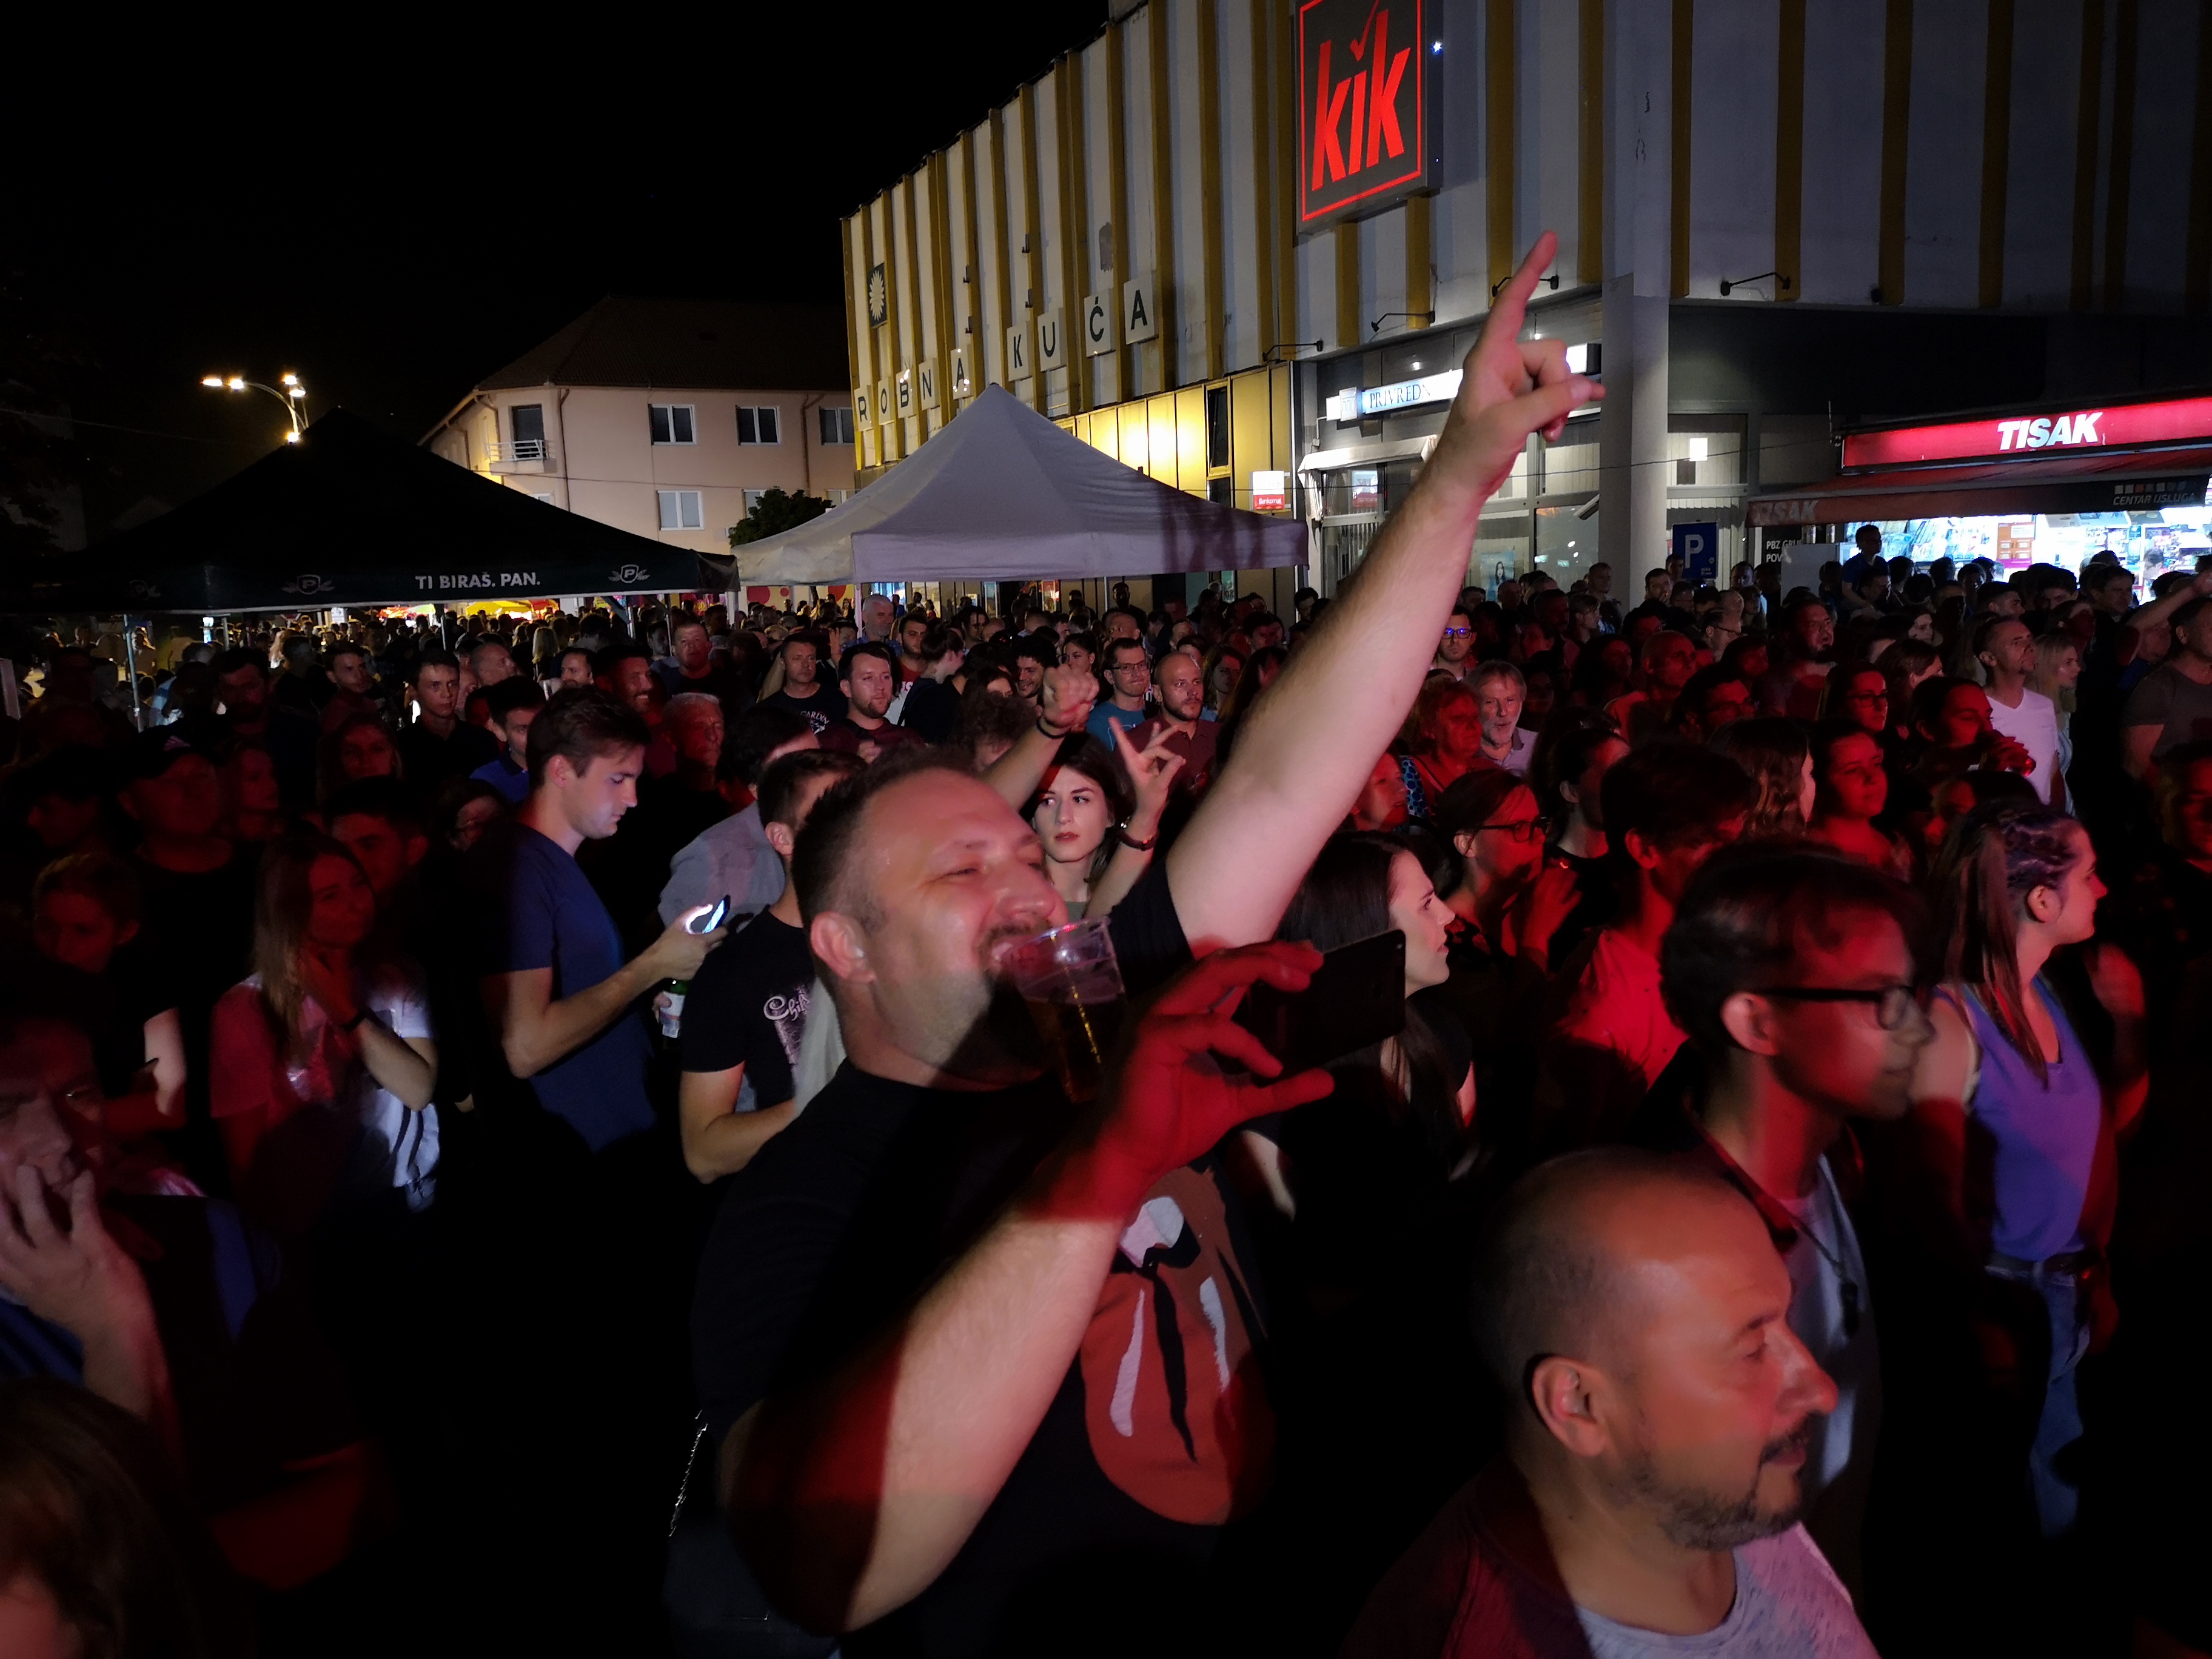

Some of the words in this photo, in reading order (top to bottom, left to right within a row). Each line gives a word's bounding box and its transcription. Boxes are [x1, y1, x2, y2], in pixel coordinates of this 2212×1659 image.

[858, 358, 968, 422] ROBNA
[1013, 289, 1147, 369] KUĆA
[1997, 412, 2103, 451] TISAK
[1258, 497, 1282, 506] Bankomat
[2113, 495, 2152, 506] CENTAR
[1684, 534, 1704, 569] P
[1766, 541, 1781, 550] PBZ
[415, 575, 432, 589] TI
[439, 572, 496, 589] BIRAŠ.
[500, 572, 541, 587] PAN.
